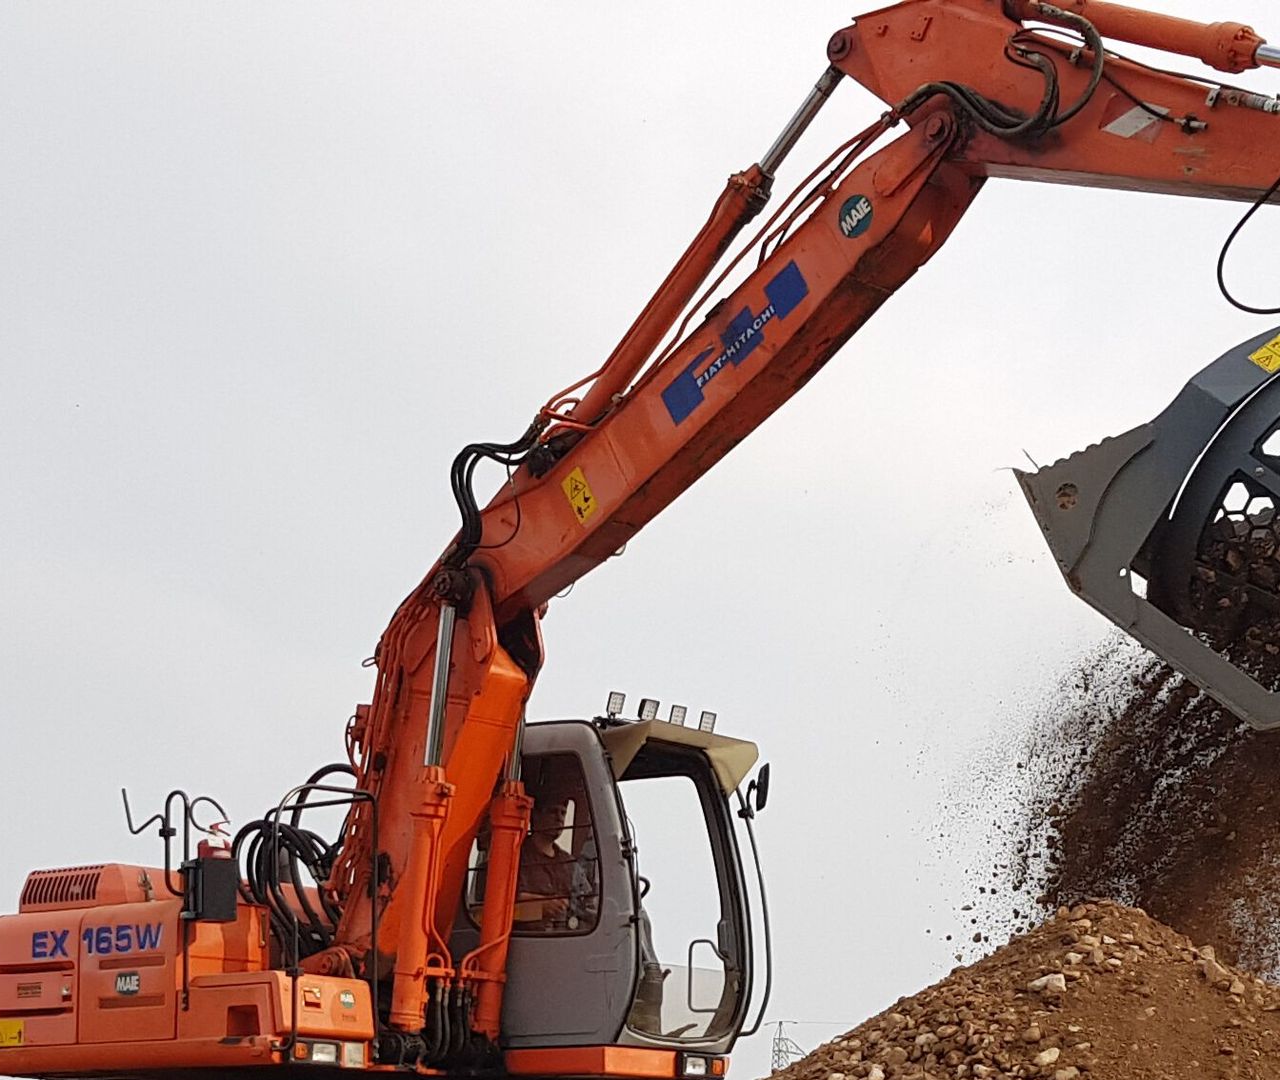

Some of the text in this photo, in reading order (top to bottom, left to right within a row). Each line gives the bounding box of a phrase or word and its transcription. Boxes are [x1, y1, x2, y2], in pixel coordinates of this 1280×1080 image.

[841, 197, 872, 236] MAIE
[696, 305, 776, 388] FIAT-HITACHI
[32, 923, 163, 958] EX 165W
[116, 975, 140, 992] MAIE
